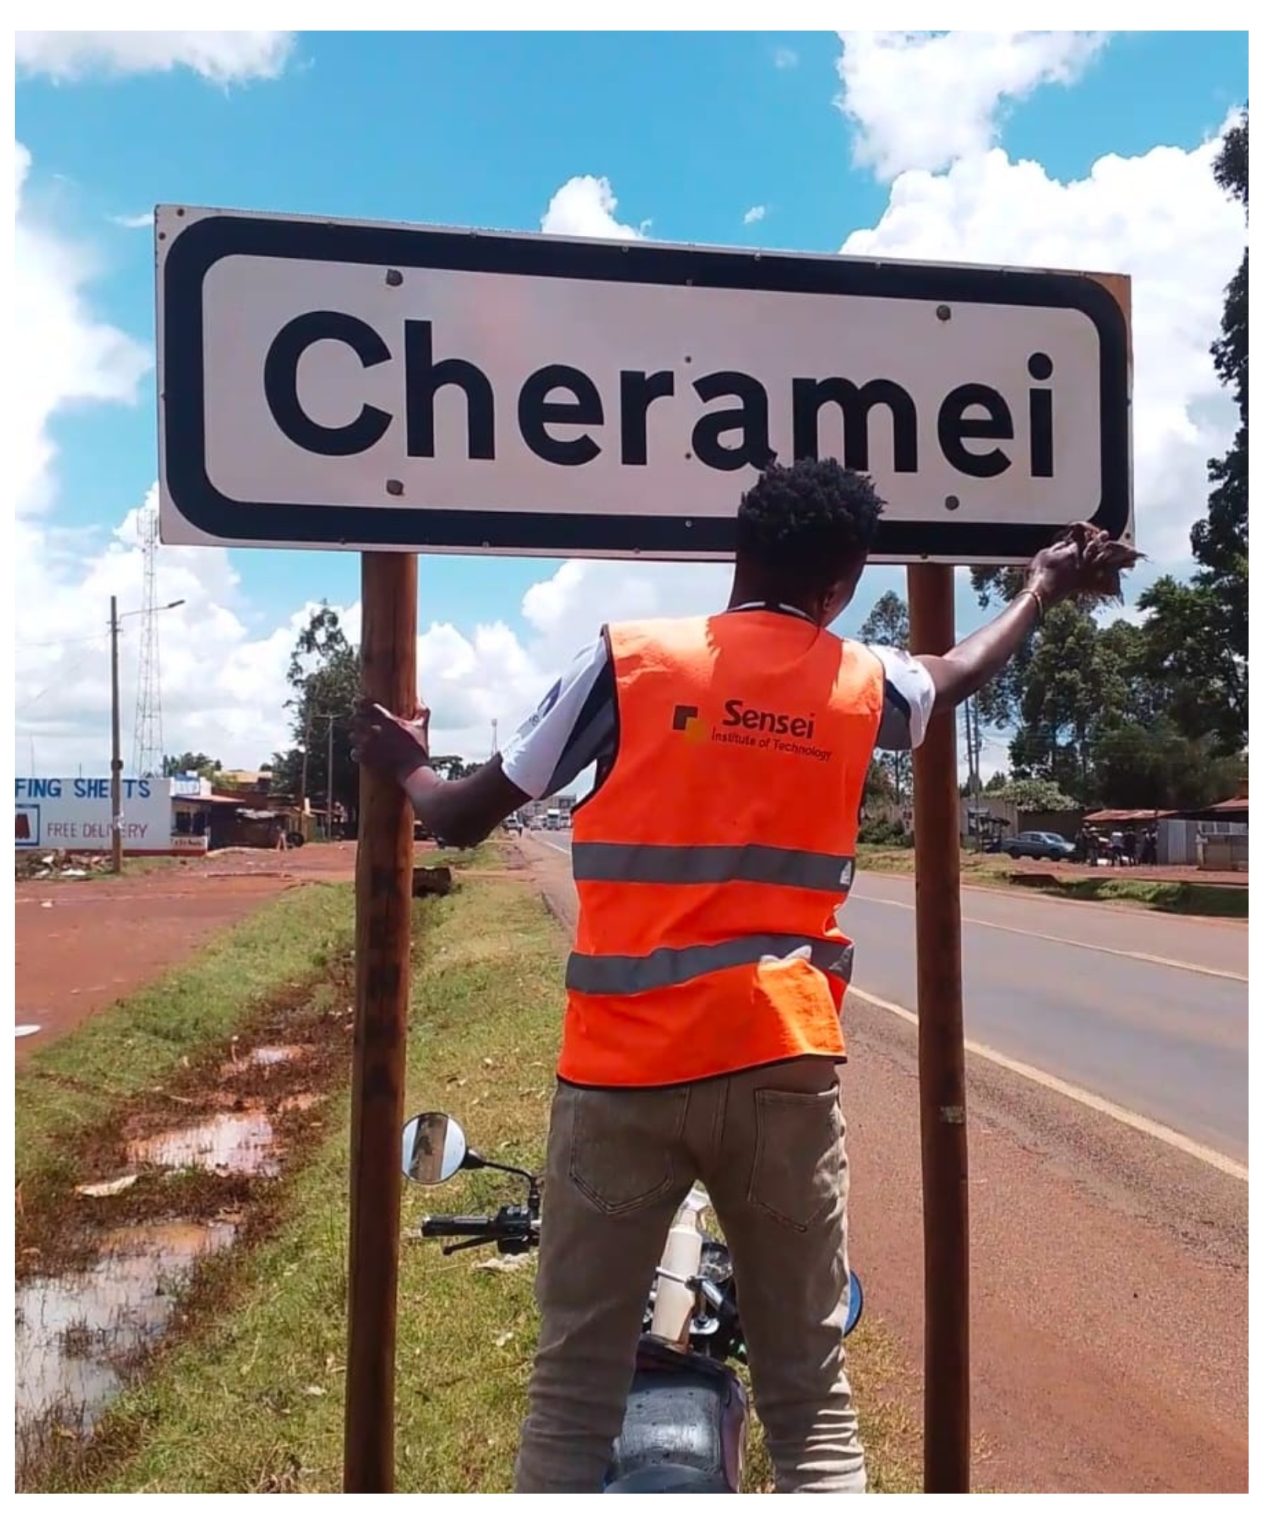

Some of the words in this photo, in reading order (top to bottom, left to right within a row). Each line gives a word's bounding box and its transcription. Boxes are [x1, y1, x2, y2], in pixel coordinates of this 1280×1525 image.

[263, 309, 1055, 479] Cheramei
[722, 699, 817, 739] Sensei
[711, 725, 756, 746] Institute
[759, 736, 771, 749] of
[772, 738, 833, 762] Technology
[15, 778, 62, 799] FING
[73, 778, 152, 799] SHETS
[47, 822, 77, 838] FREE
[82, 822, 148, 839] DELIERY
